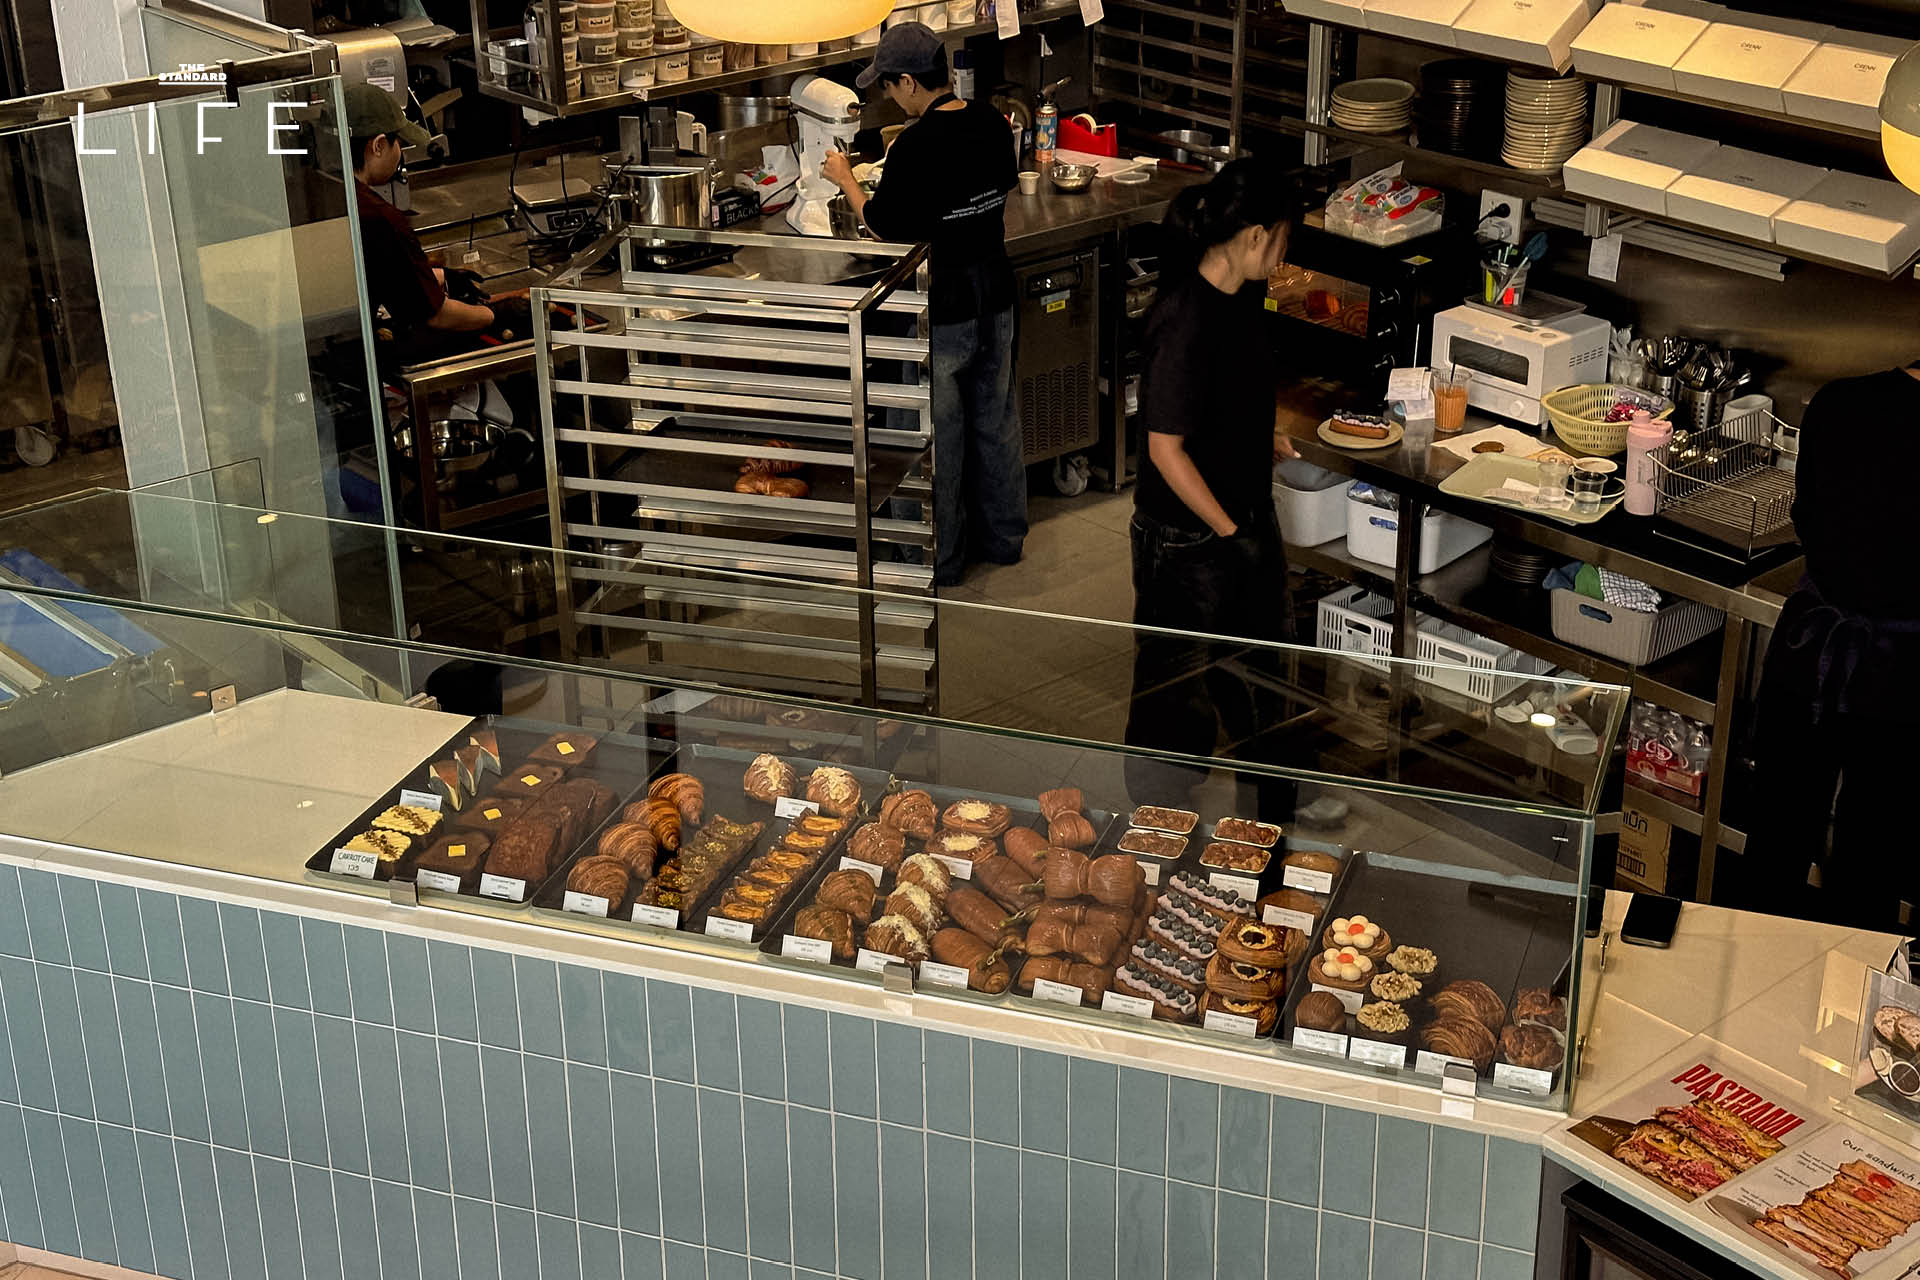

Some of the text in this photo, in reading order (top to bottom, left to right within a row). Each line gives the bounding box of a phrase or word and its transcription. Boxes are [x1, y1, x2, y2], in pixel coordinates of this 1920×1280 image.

[338, 852, 376, 865] CARROT CAKE
[1670, 1063, 1806, 1140] PASTRAMI
[1842, 1139, 1863, 1153] Our
[1865, 1153, 1915, 1182] sandwich
